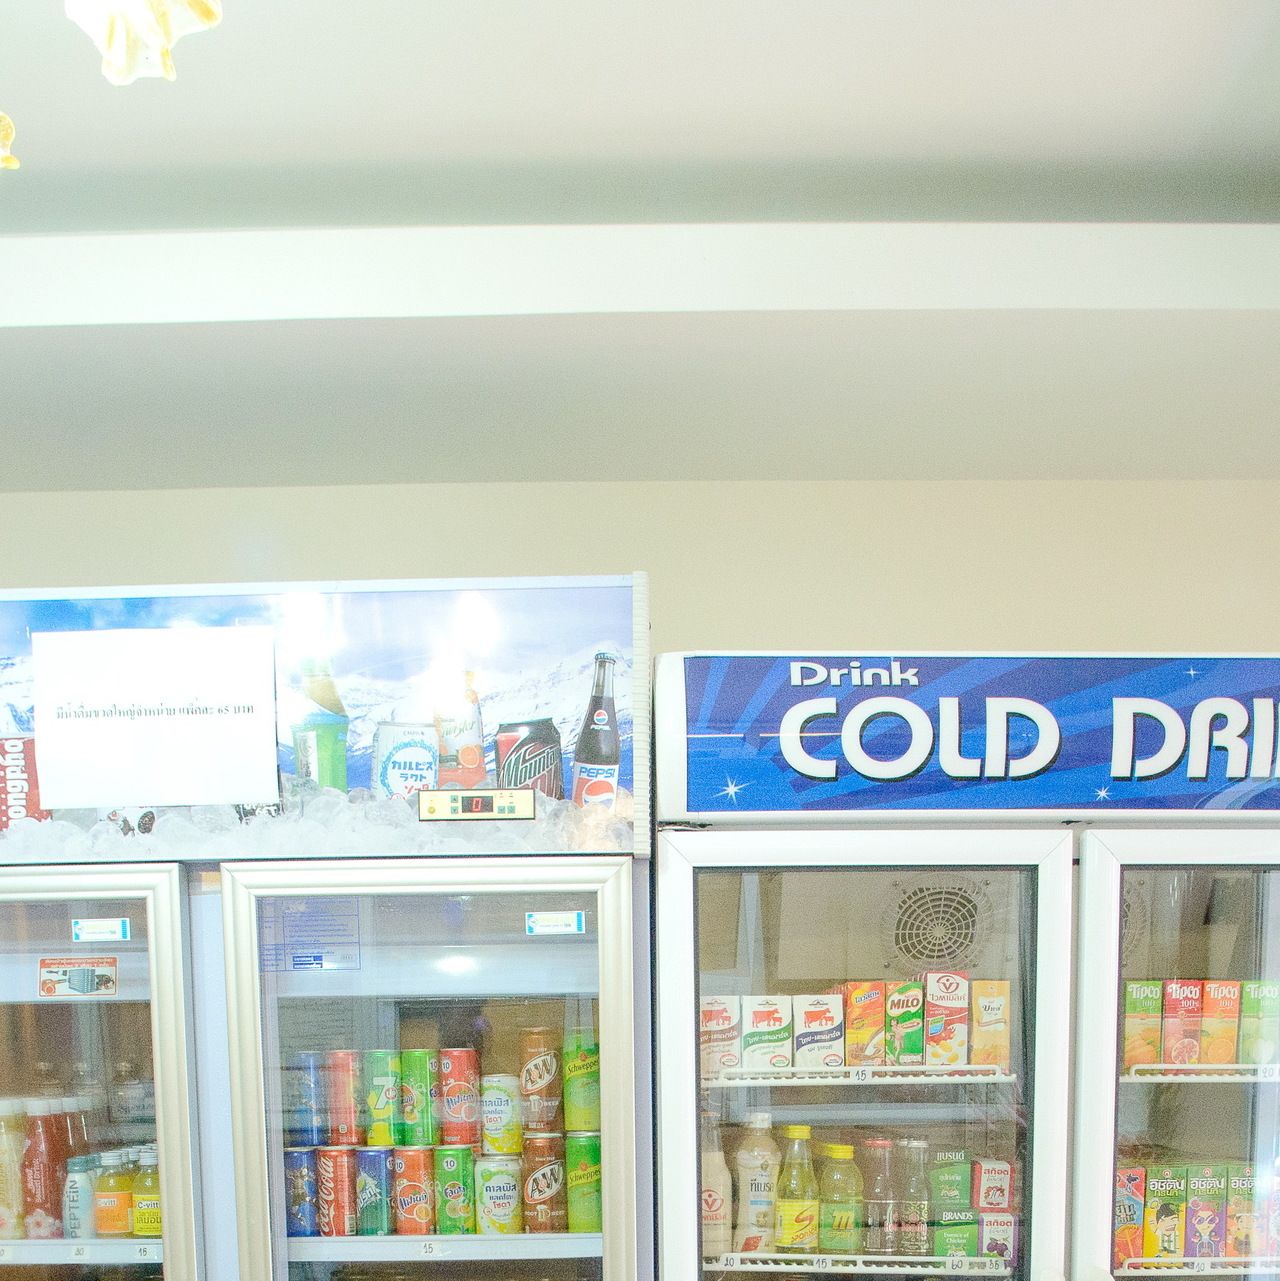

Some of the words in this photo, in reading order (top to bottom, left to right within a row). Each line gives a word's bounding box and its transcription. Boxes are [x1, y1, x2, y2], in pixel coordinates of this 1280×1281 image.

[789, 660, 920, 688] Drink
[778, 696, 1062, 781] COLD
[390, 760, 434, 771] カルピス
[579, 765, 616, 779] PEPSI
[1131, 984, 1161, 1000] Tipco
[1167, 983, 1200, 1001] Tipco
[1206, 984, 1239, 1001] Tipco
[1245, 984, 1279, 1001] Tipco
[889, 997, 920, 1010] MILO
[441, 1061, 450, 1070] 10
[855, 1069, 867, 1081] 15
[446, 1159, 455, 1168] 10
[423, 1243, 434, 1255] 15
[815, 1258, 828, 1269] 15
